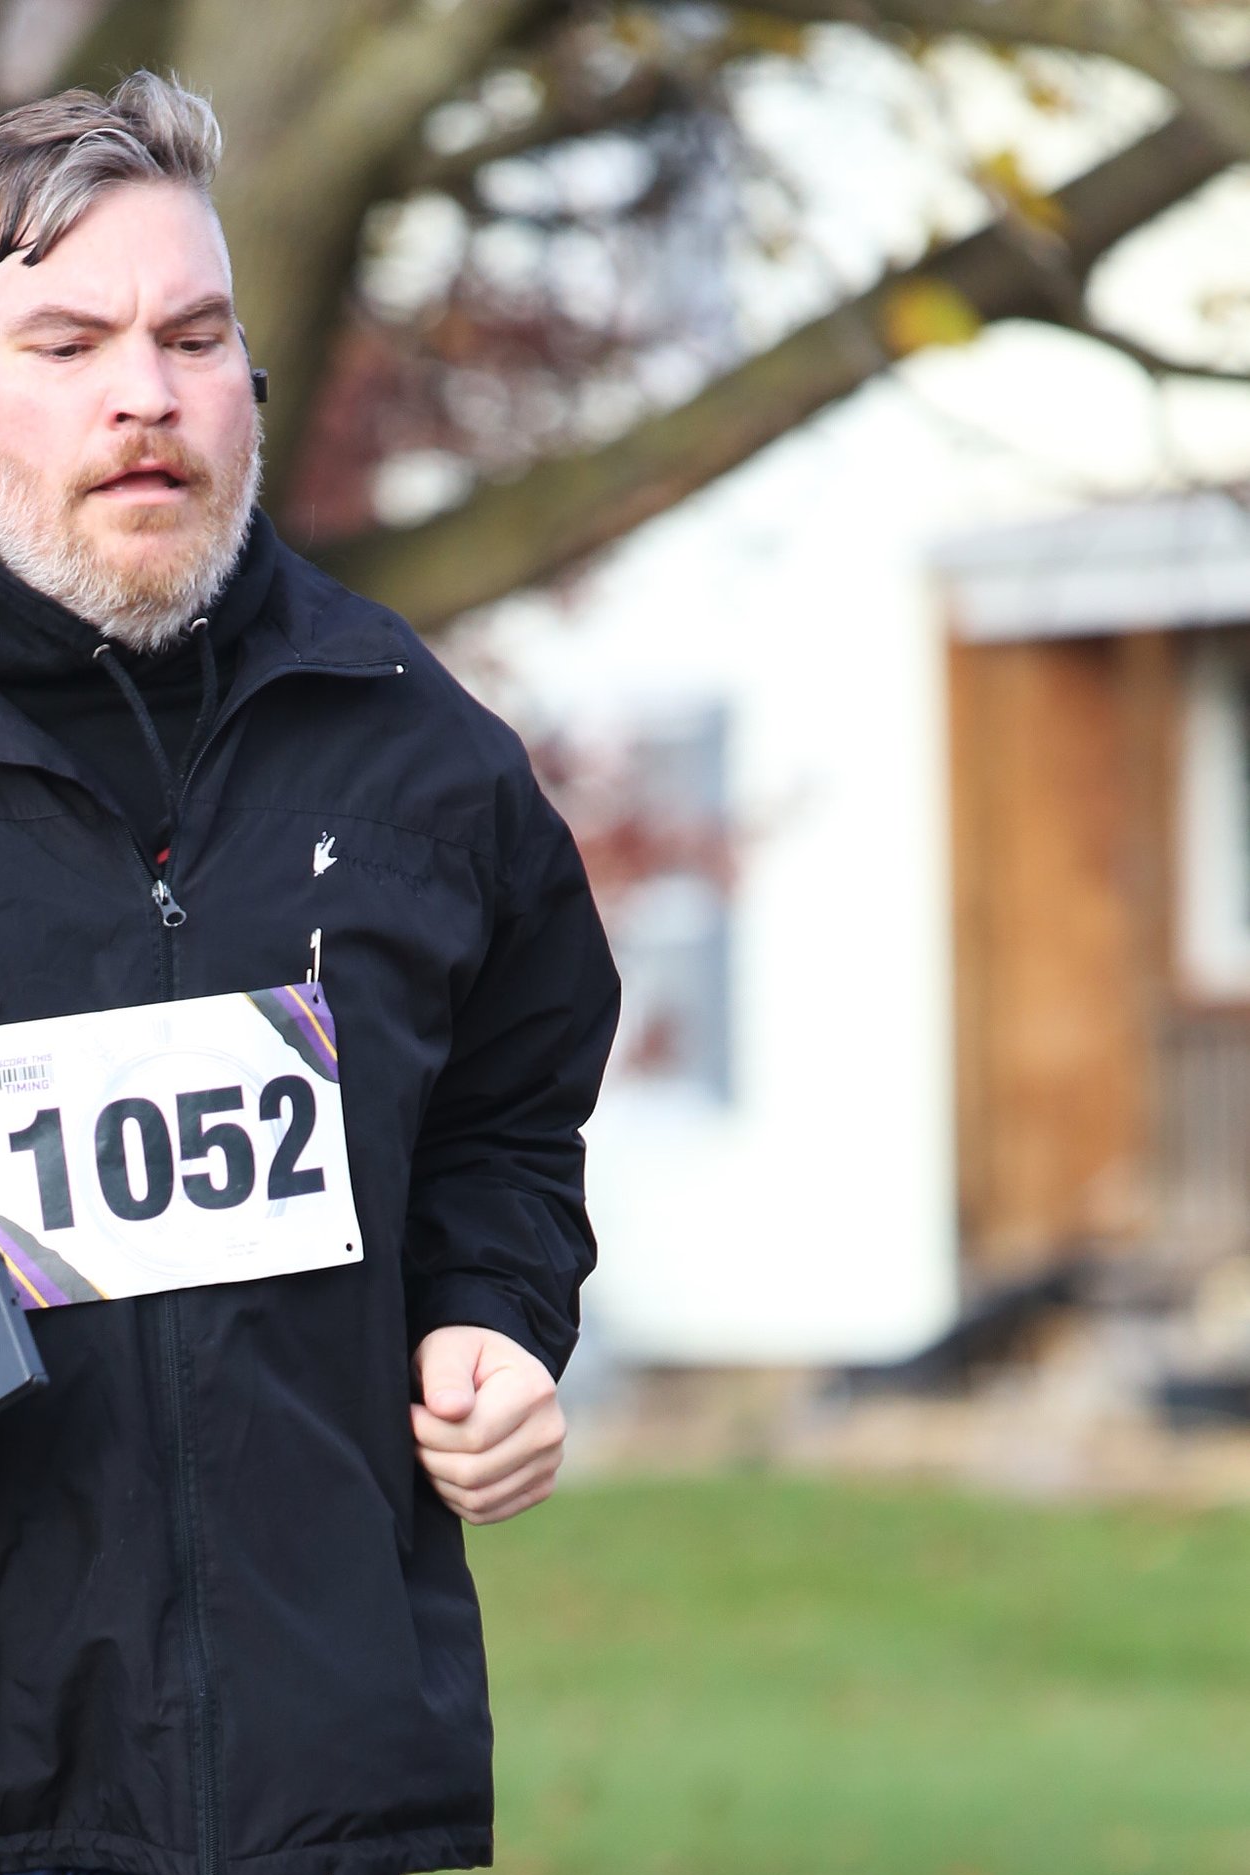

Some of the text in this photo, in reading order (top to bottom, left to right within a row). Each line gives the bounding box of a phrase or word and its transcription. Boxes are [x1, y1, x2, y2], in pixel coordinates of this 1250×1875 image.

[31, 1053, 53, 1064] THIS
[4, 1079, 49, 1094] TIMING
[8, 1074, 326, 1232] 1052
